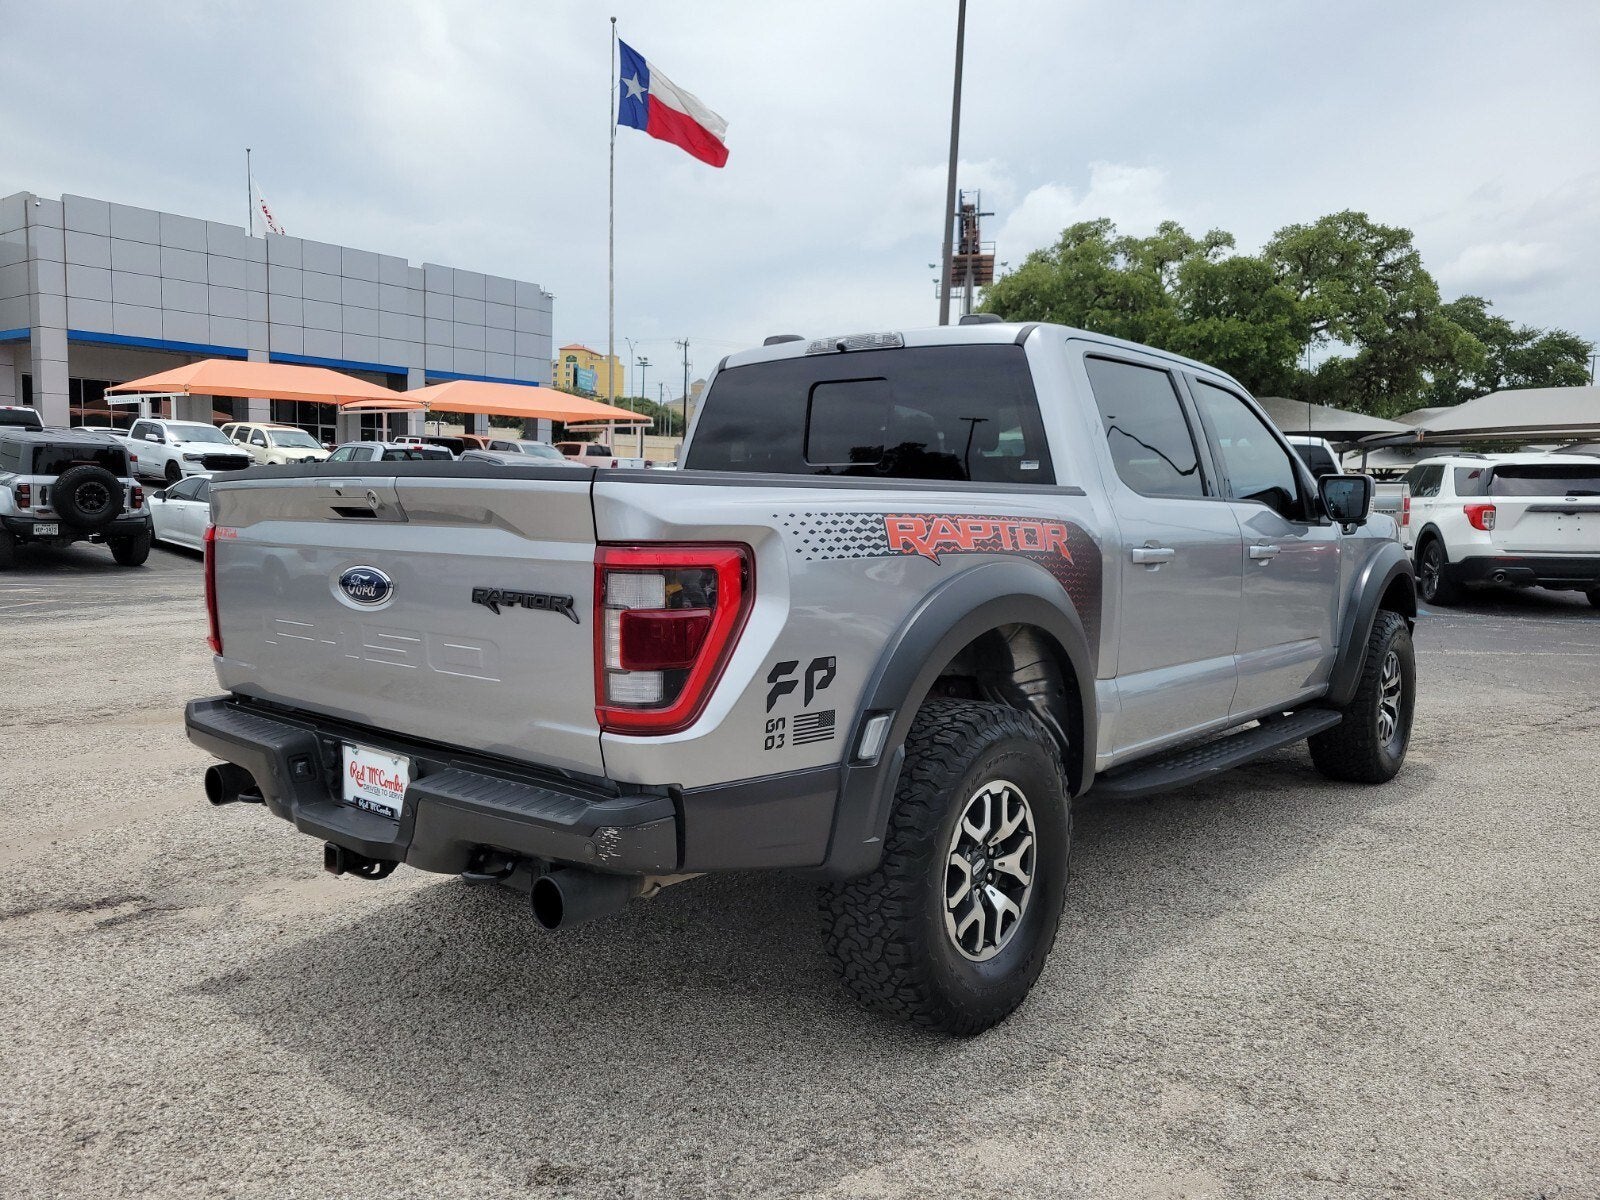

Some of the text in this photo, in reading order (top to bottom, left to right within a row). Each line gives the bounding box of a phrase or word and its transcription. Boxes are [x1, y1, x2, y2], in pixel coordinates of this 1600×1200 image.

[884, 516, 1074, 566] RAPTOR
[346, 572, 378, 599] Ford
[471, 586, 580, 624] RAPTOR
[349, 760, 404, 793] Red McCombs
[358, 799, 369, 810] Red
[363, 783, 404, 801] DRIVEN TO SERVE
